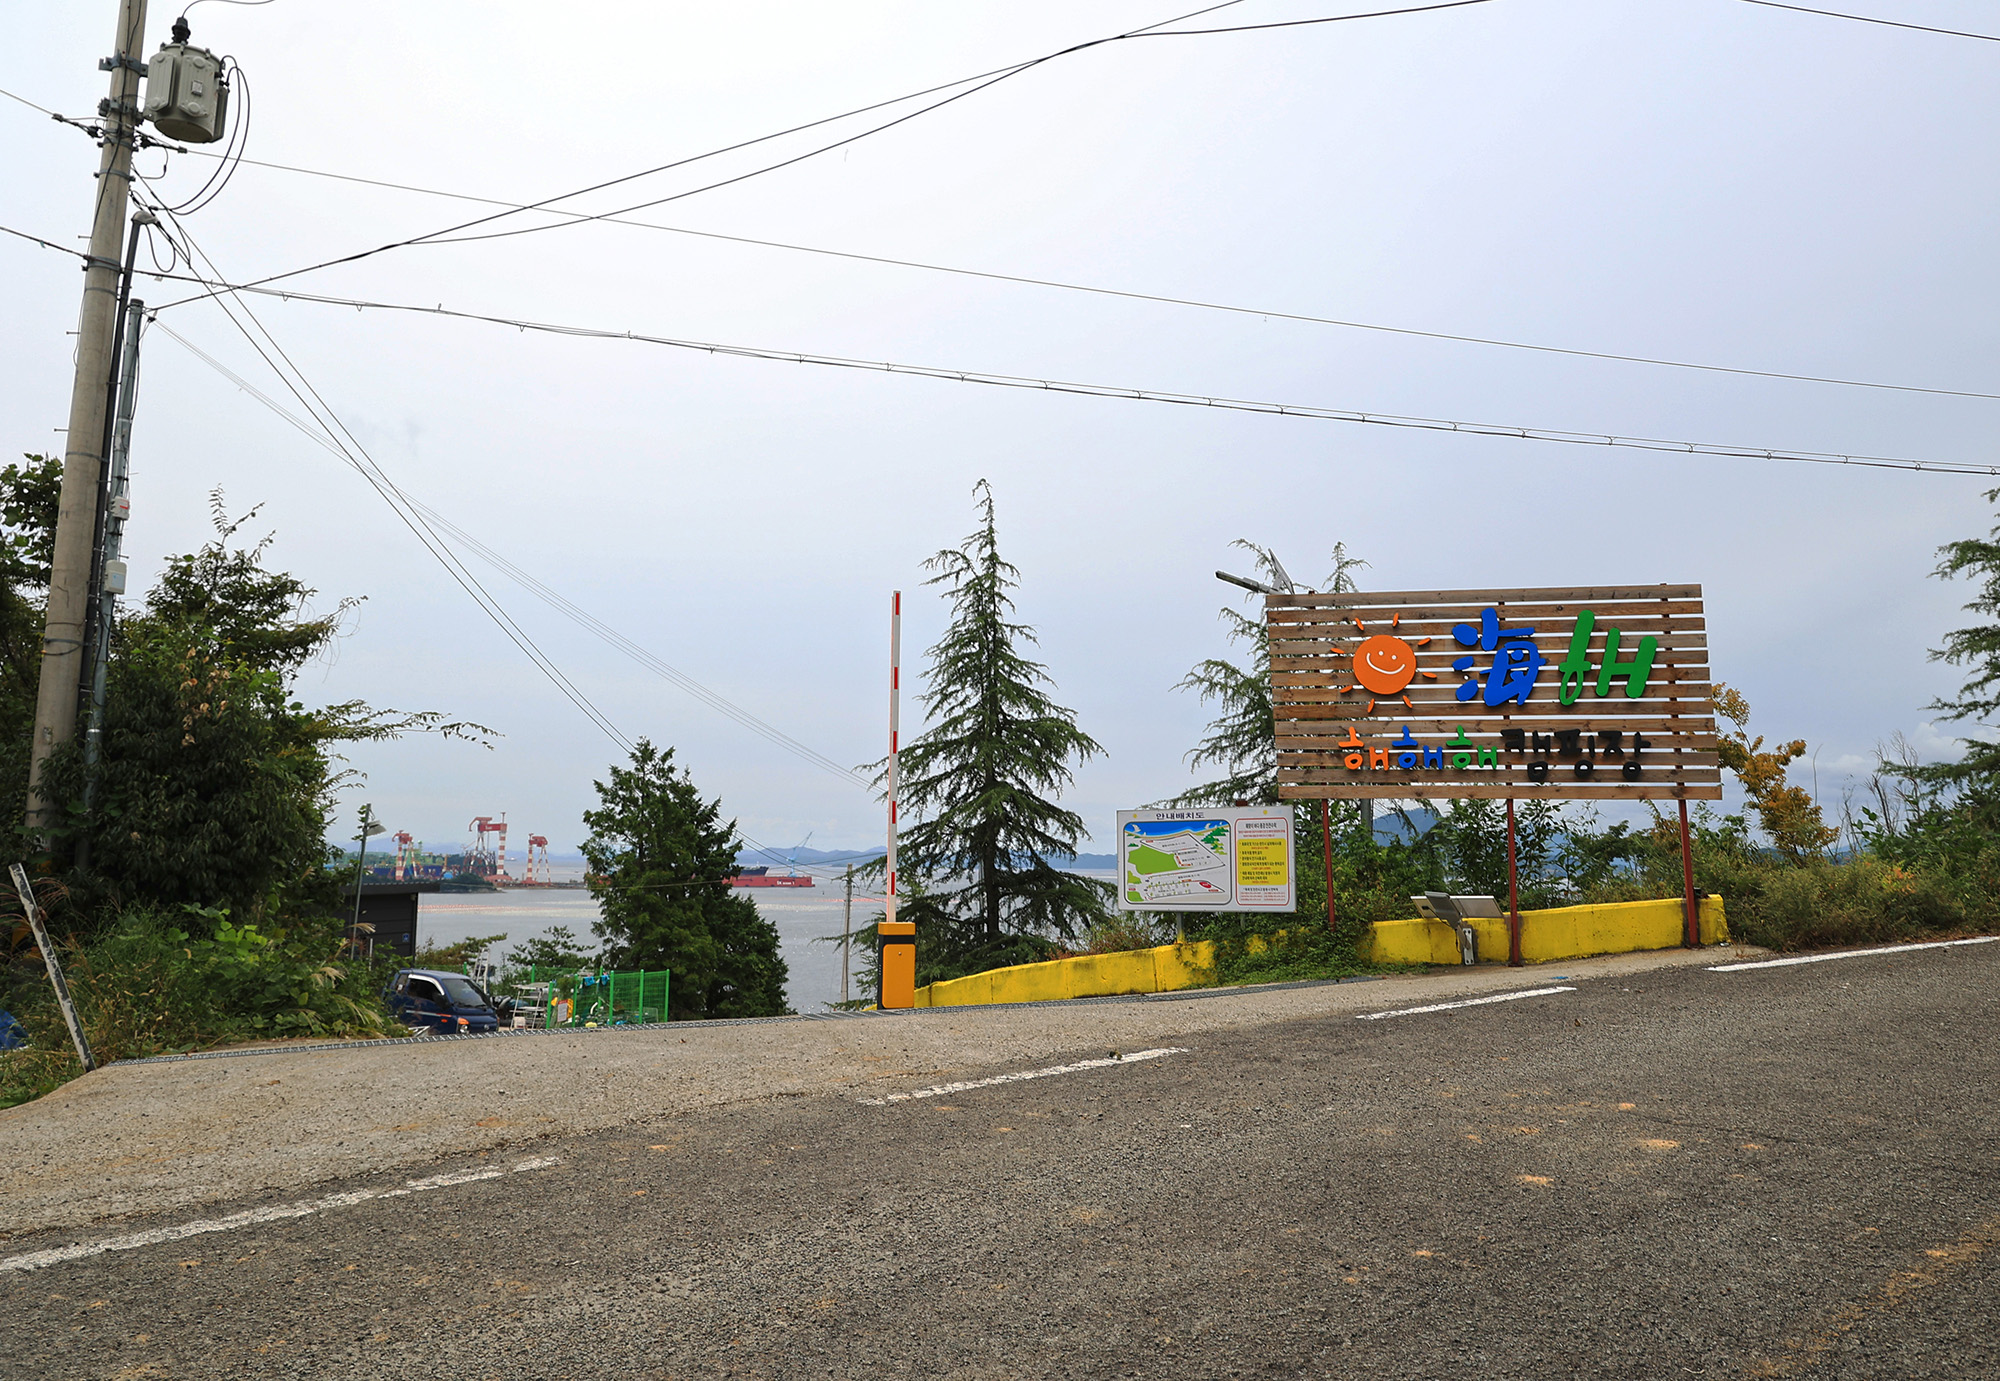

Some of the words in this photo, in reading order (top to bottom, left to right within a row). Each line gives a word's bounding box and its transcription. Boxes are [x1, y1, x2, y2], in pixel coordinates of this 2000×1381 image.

[1452, 607, 1546, 707] 海
[1338, 725, 1498, 771] 해해해
[1501, 728, 1651, 782] 캠핑장
